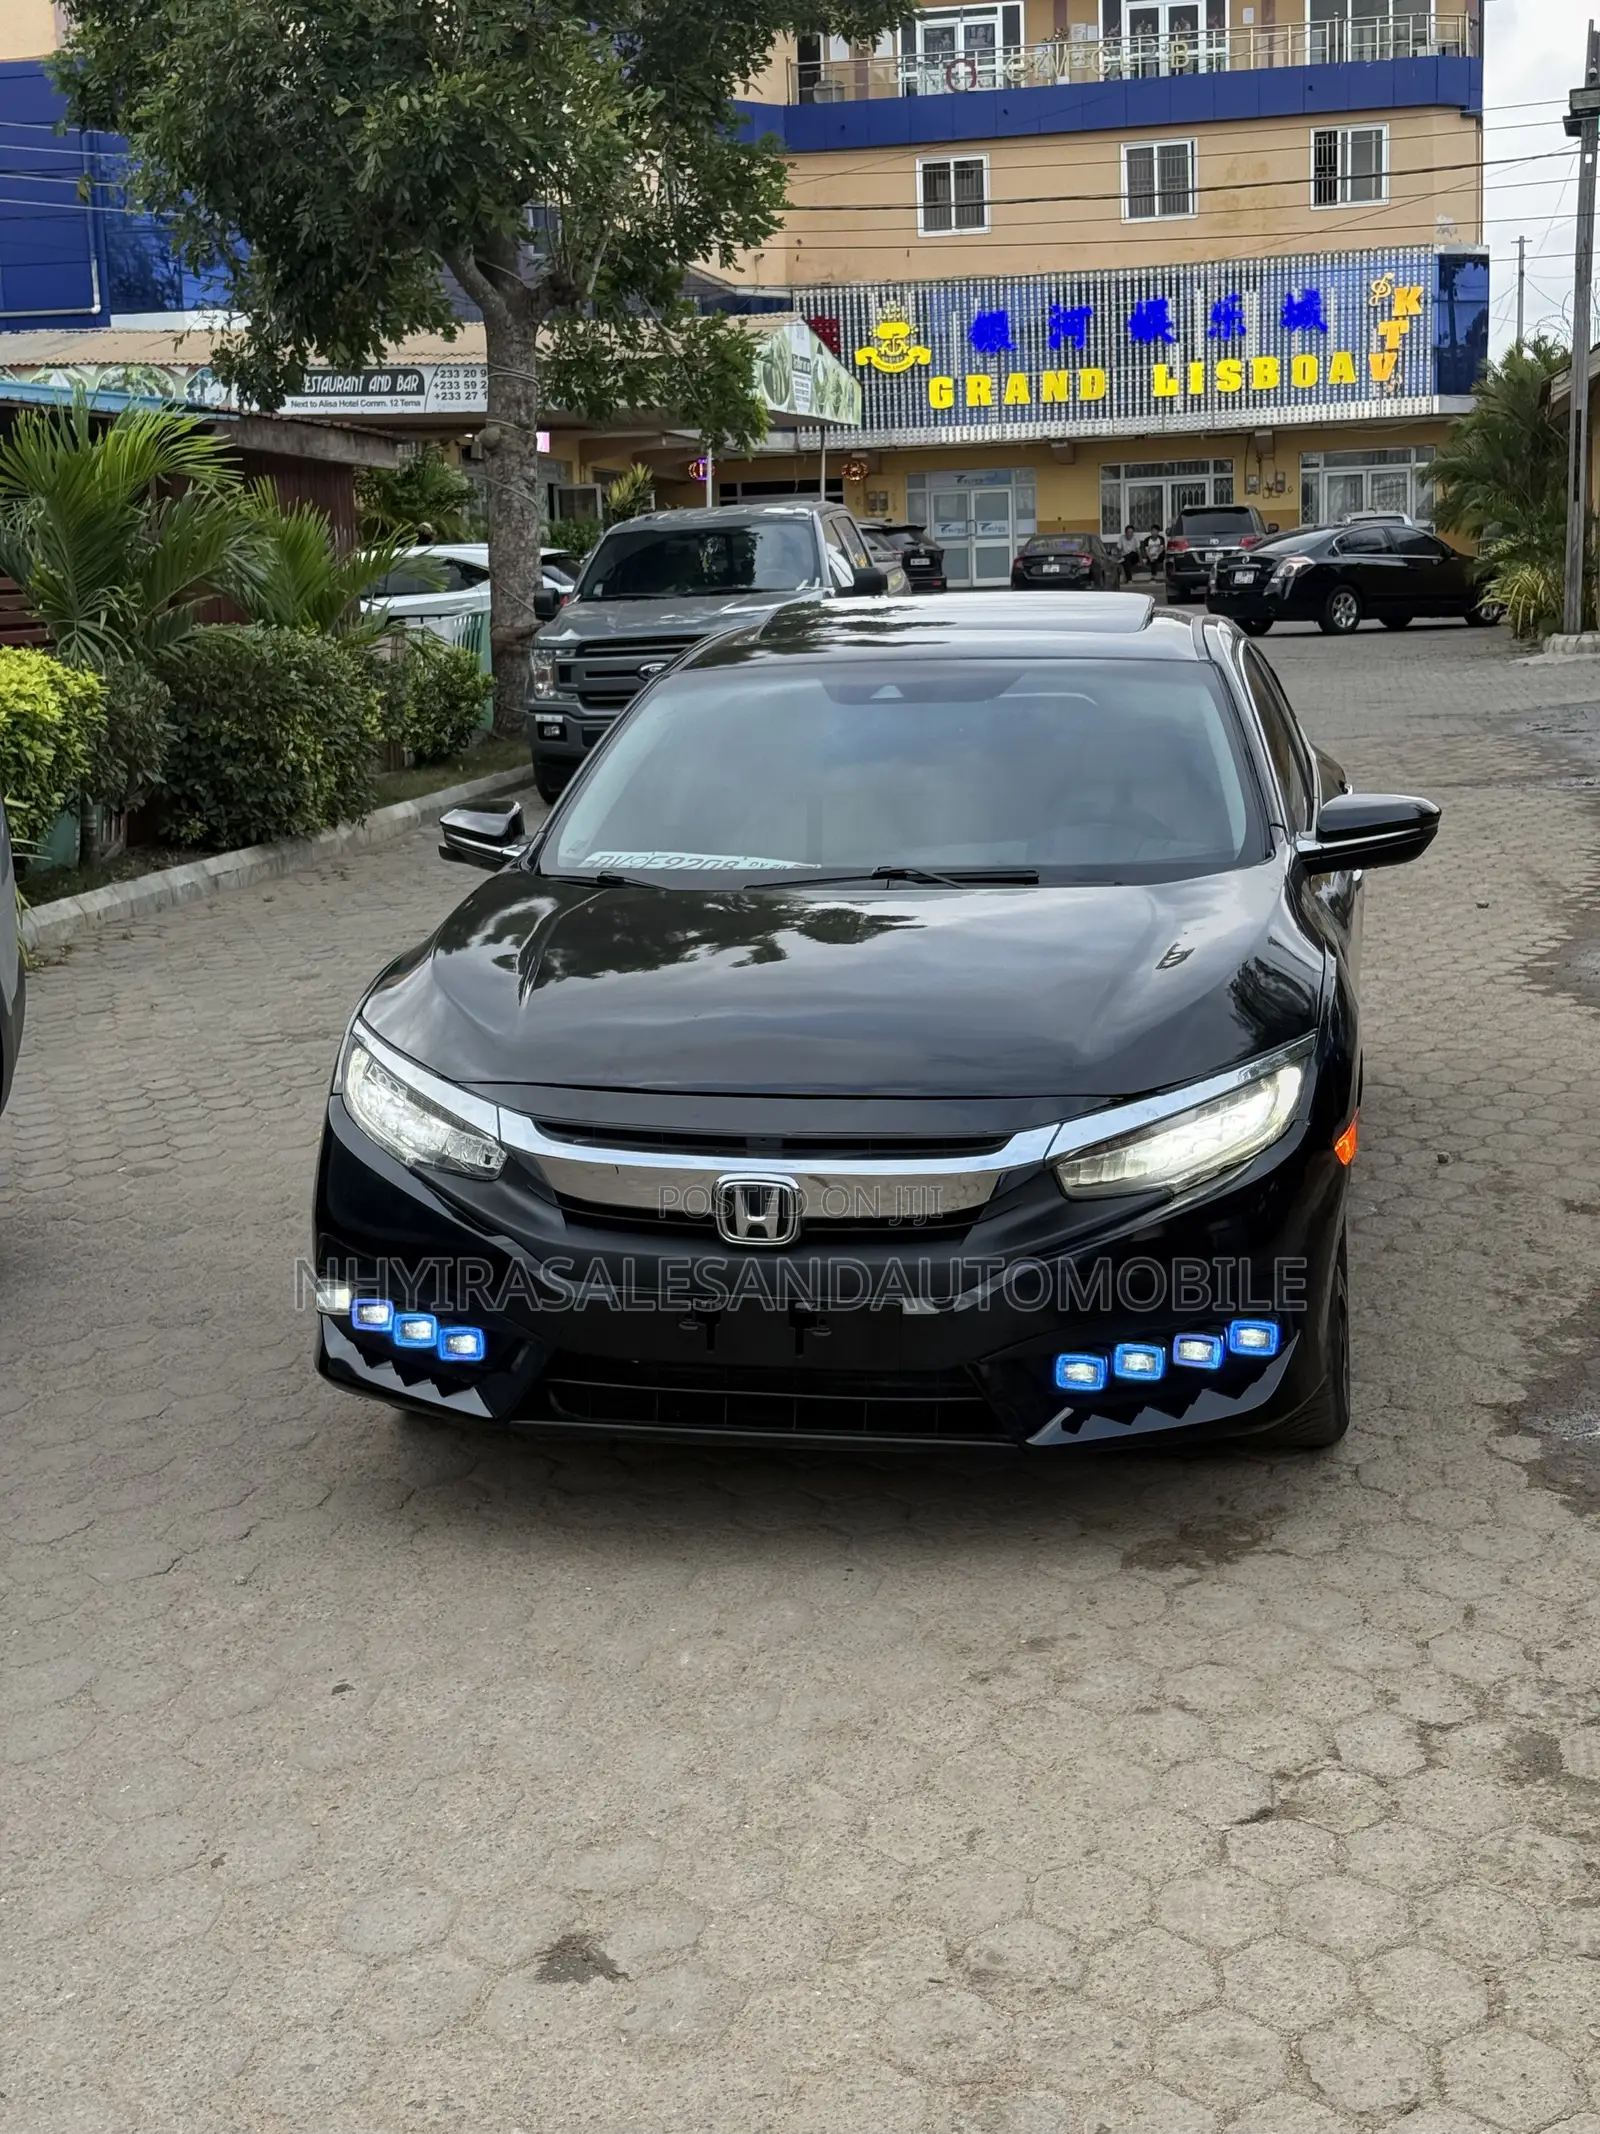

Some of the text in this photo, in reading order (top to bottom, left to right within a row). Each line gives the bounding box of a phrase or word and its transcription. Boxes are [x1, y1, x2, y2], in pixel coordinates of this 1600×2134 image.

[1369, 286, 1423, 382] KTV
[434, 369, 460, 379] +233
[463, 369, 477, 378] 20
[368, 374, 391, 392] AND
[396, 374, 420, 392] BAR
[928, 351, 1356, 409] GRAND LISBOA
[433, 381, 461, 390] +233
[434, 392, 461, 401] +233
[465, 392, 477, 400] 27
[291, 400, 309, 408] Next
[310, 400, 317, 408] to
[319, 399, 337, 408] Alisa
[339, 399, 359, 408] Hotel
[390, 399, 399, 407] 12
[401, 399, 421, 407] Tema
